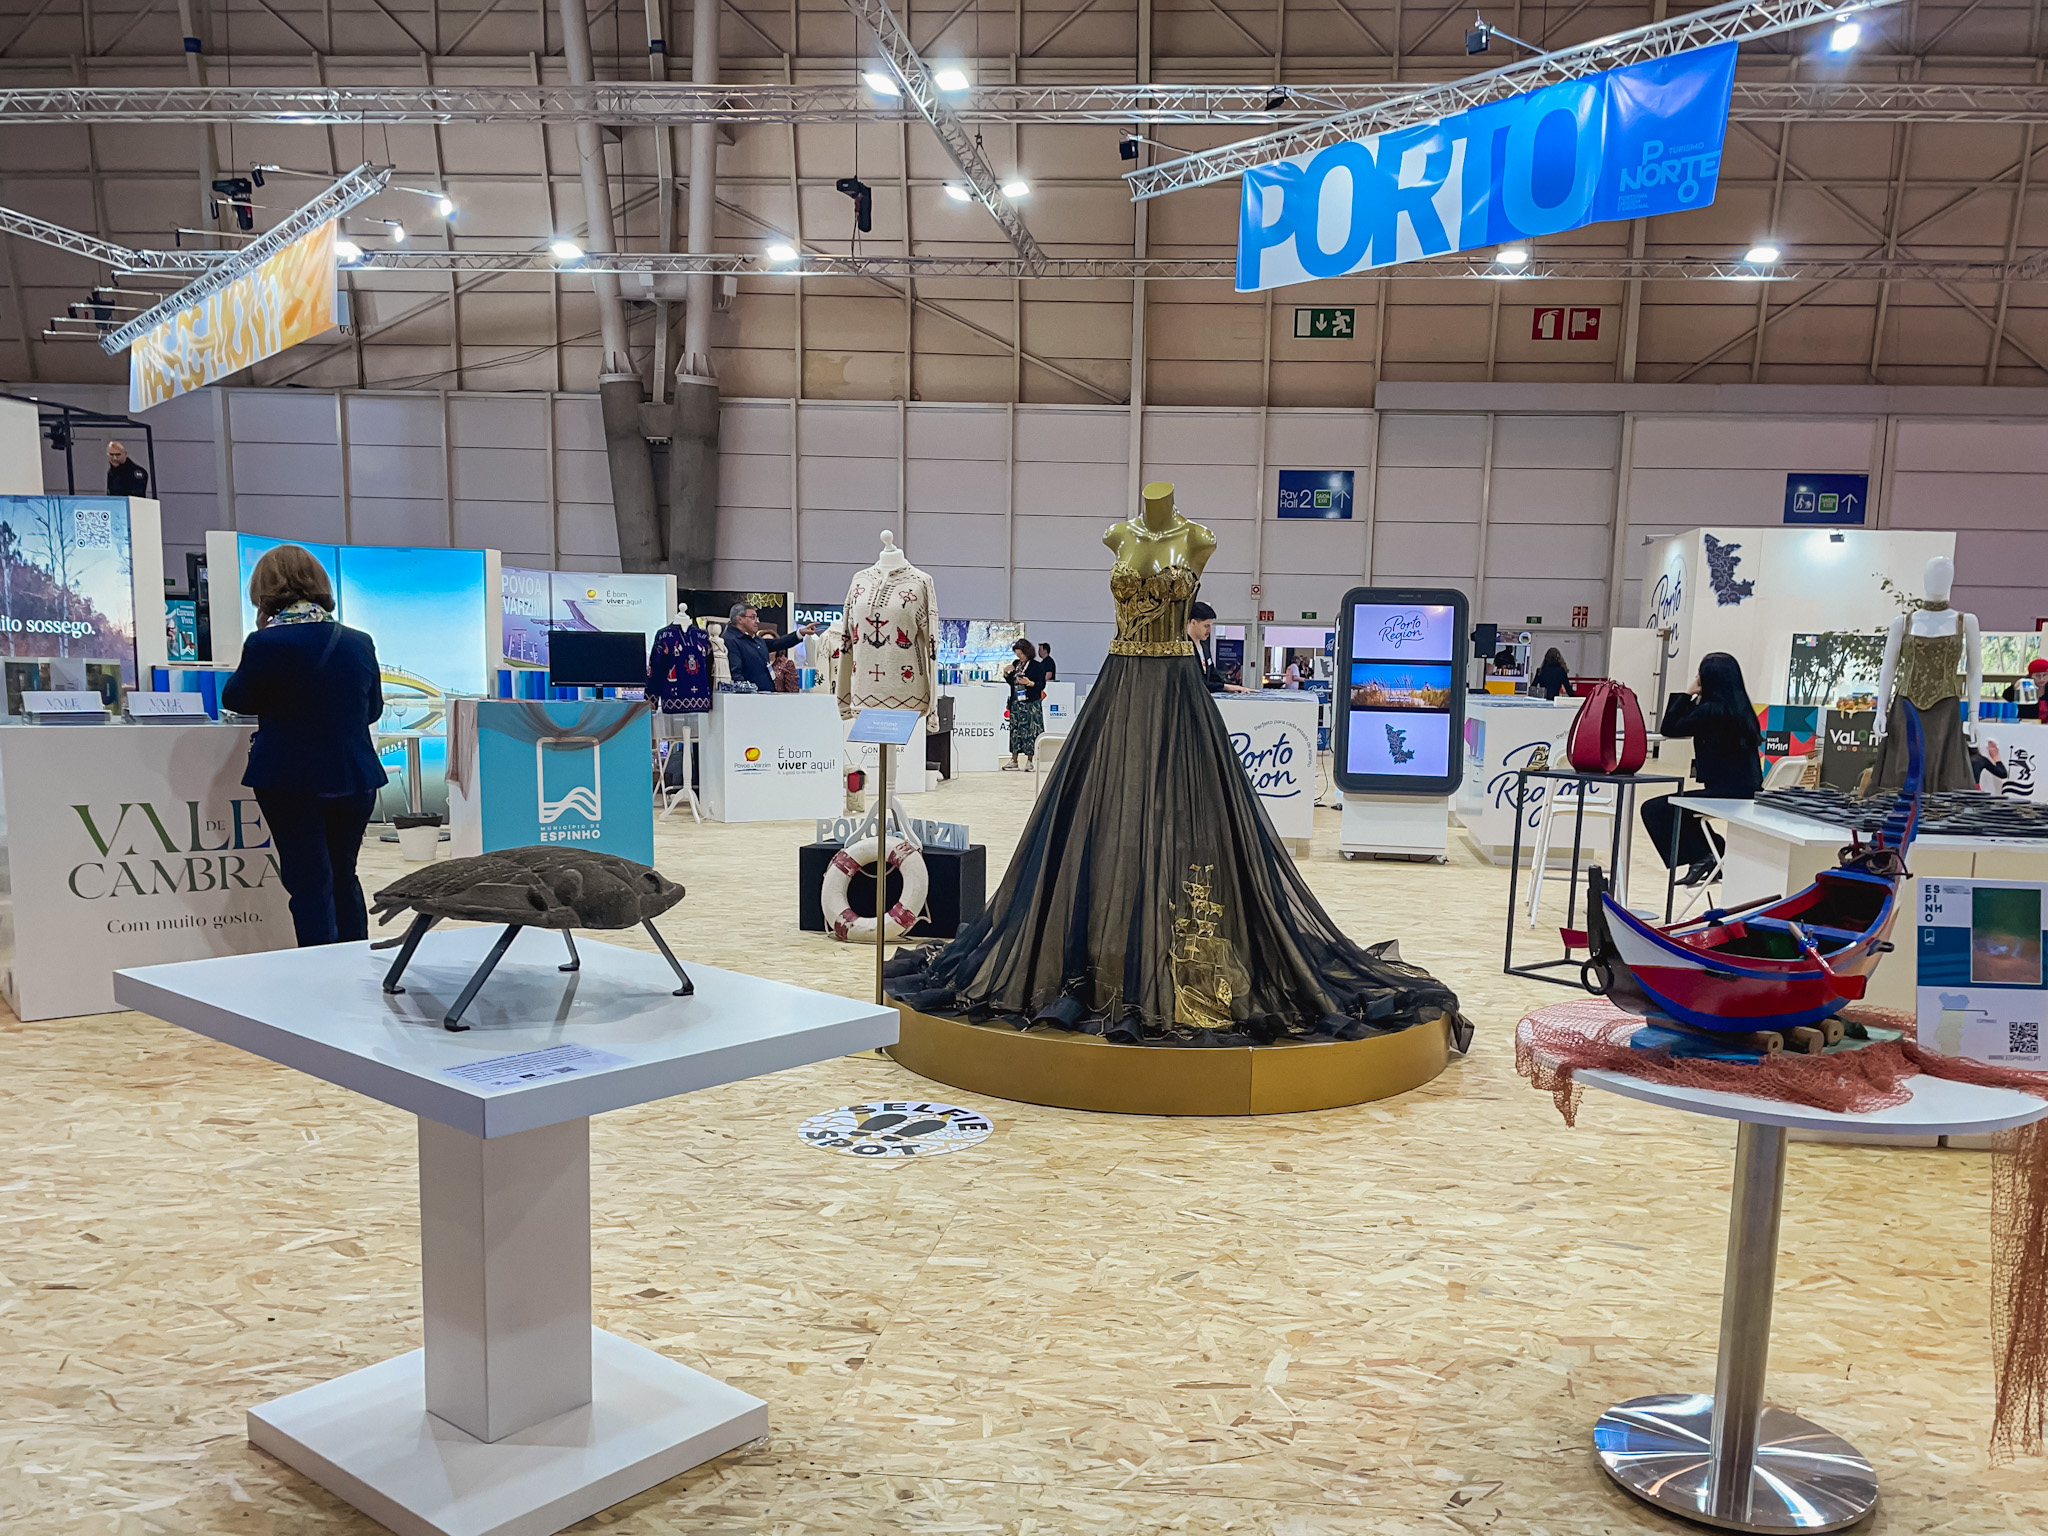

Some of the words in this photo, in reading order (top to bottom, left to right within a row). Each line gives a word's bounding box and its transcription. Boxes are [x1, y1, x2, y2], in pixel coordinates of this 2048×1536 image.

[1669, 142, 1704, 154] TURISMO
[1236, 80, 1604, 290] PORTO
[1280, 490, 1298, 499] Pav
[1300, 489, 1311, 508] 2
[1280, 499, 1298, 508] Hall
[794, 610, 843, 623] PARED
[1385, 615, 1422, 632] Porto
[26, 619, 96, 639] sossego.
[1379, 625, 1425, 650] Region
[953, 728, 995, 737] PAREDES
[778, 746, 785, 759] É
[788, 748, 812, 759] bom
[1229, 732, 1293, 769] Porto
[778, 760, 808, 770] viver
[810, 759, 835, 772] aqui!
[69, 799, 271, 857] VALE
[206, 820, 226, 831] DE
[540, 829, 600, 842] ESPINHO
[68, 853, 282, 900] CAMBRA
[107, 919, 150, 934] Com
[157, 914, 207, 930] muito
[213, 910, 263, 929] gosto.
[848, 1102, 989, 1131] SELFIE
[806, 1130, 921, 1156] SPOT
